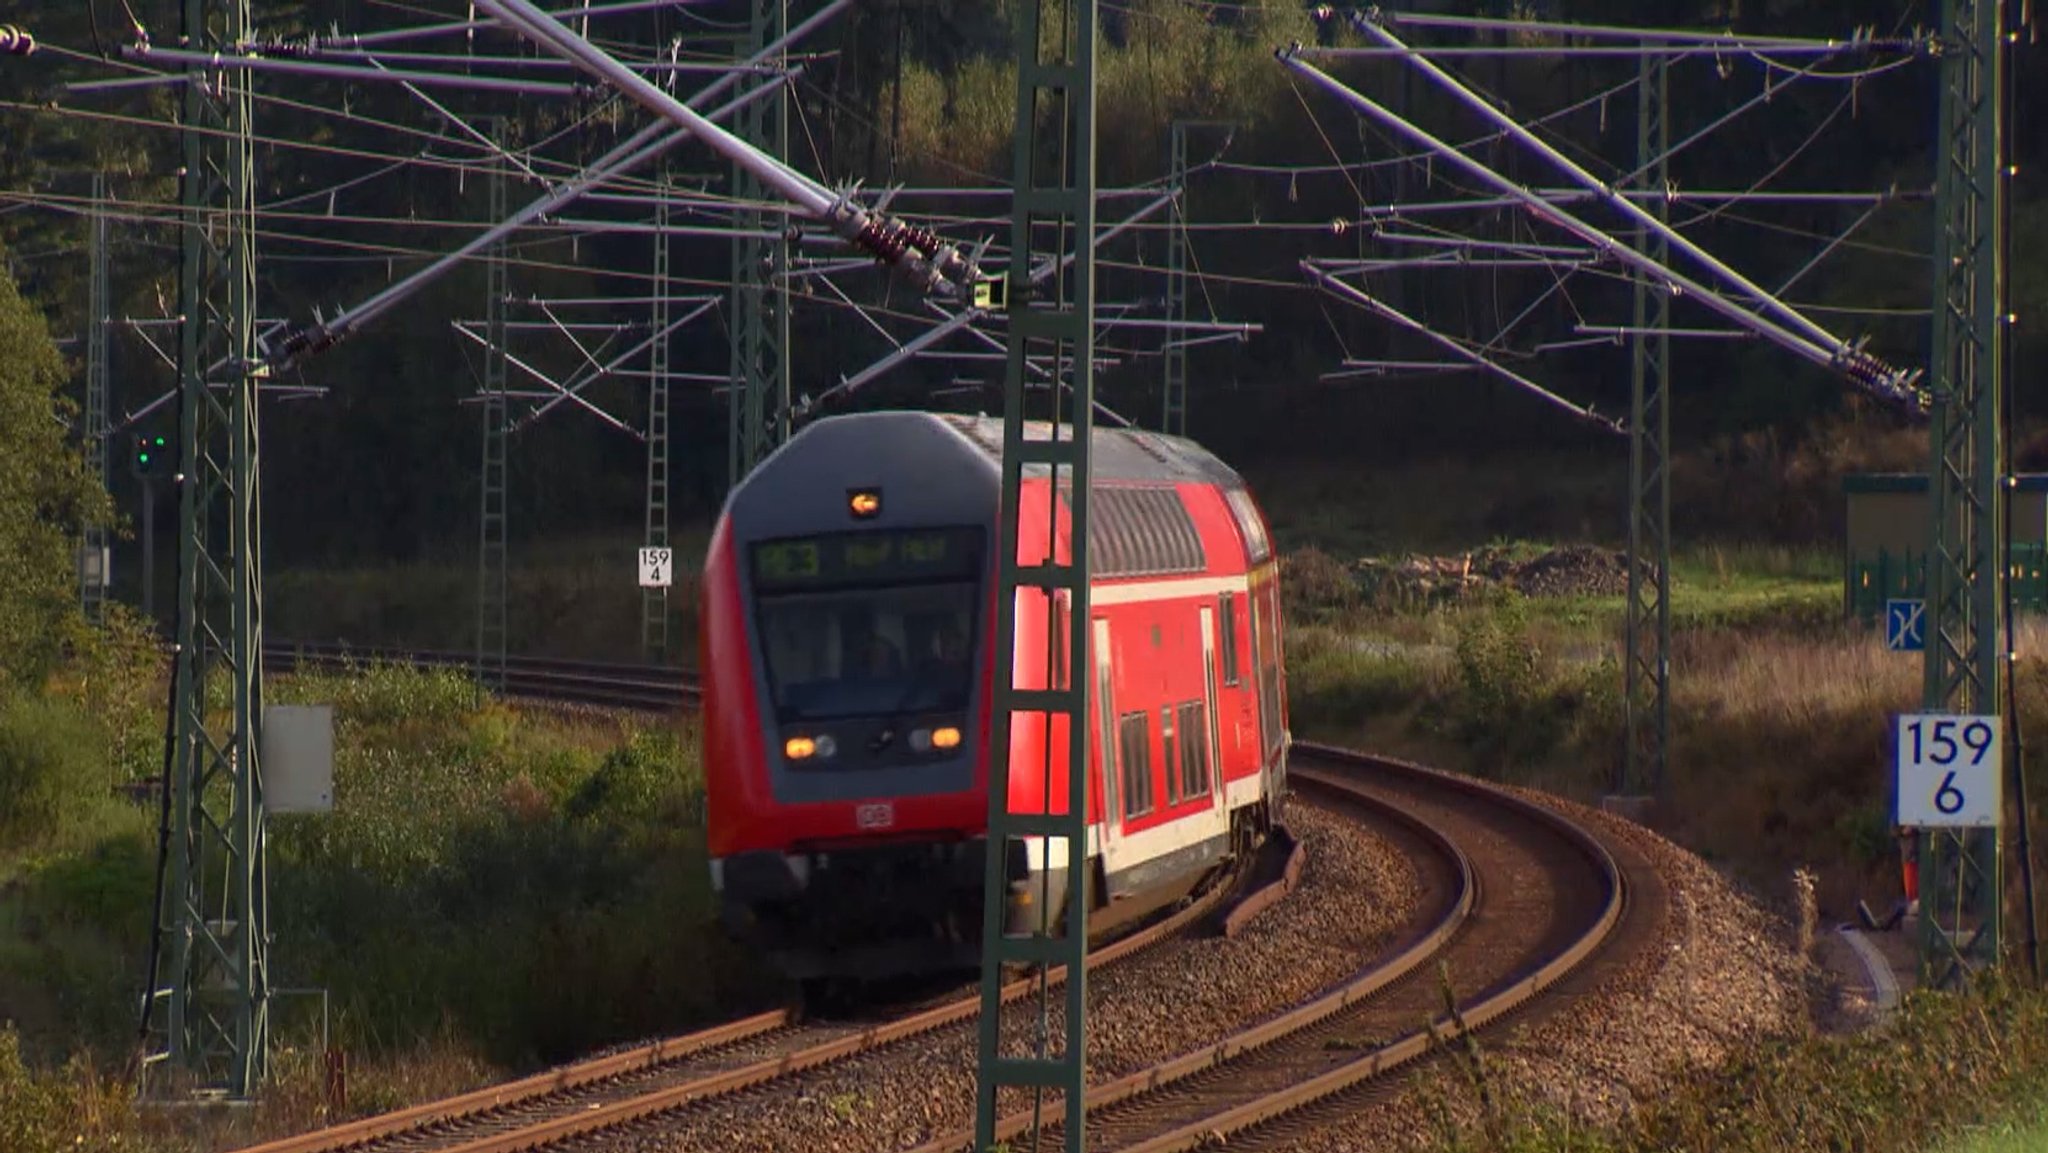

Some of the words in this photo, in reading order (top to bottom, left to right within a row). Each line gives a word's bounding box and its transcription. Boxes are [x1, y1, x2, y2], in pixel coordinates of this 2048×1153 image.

[642, 550, 669, 566] 159
[651, 566, 660, 581] 4
[1907, 720, 1992, 765] 159
[1934, 771, 1964, 814] 6
